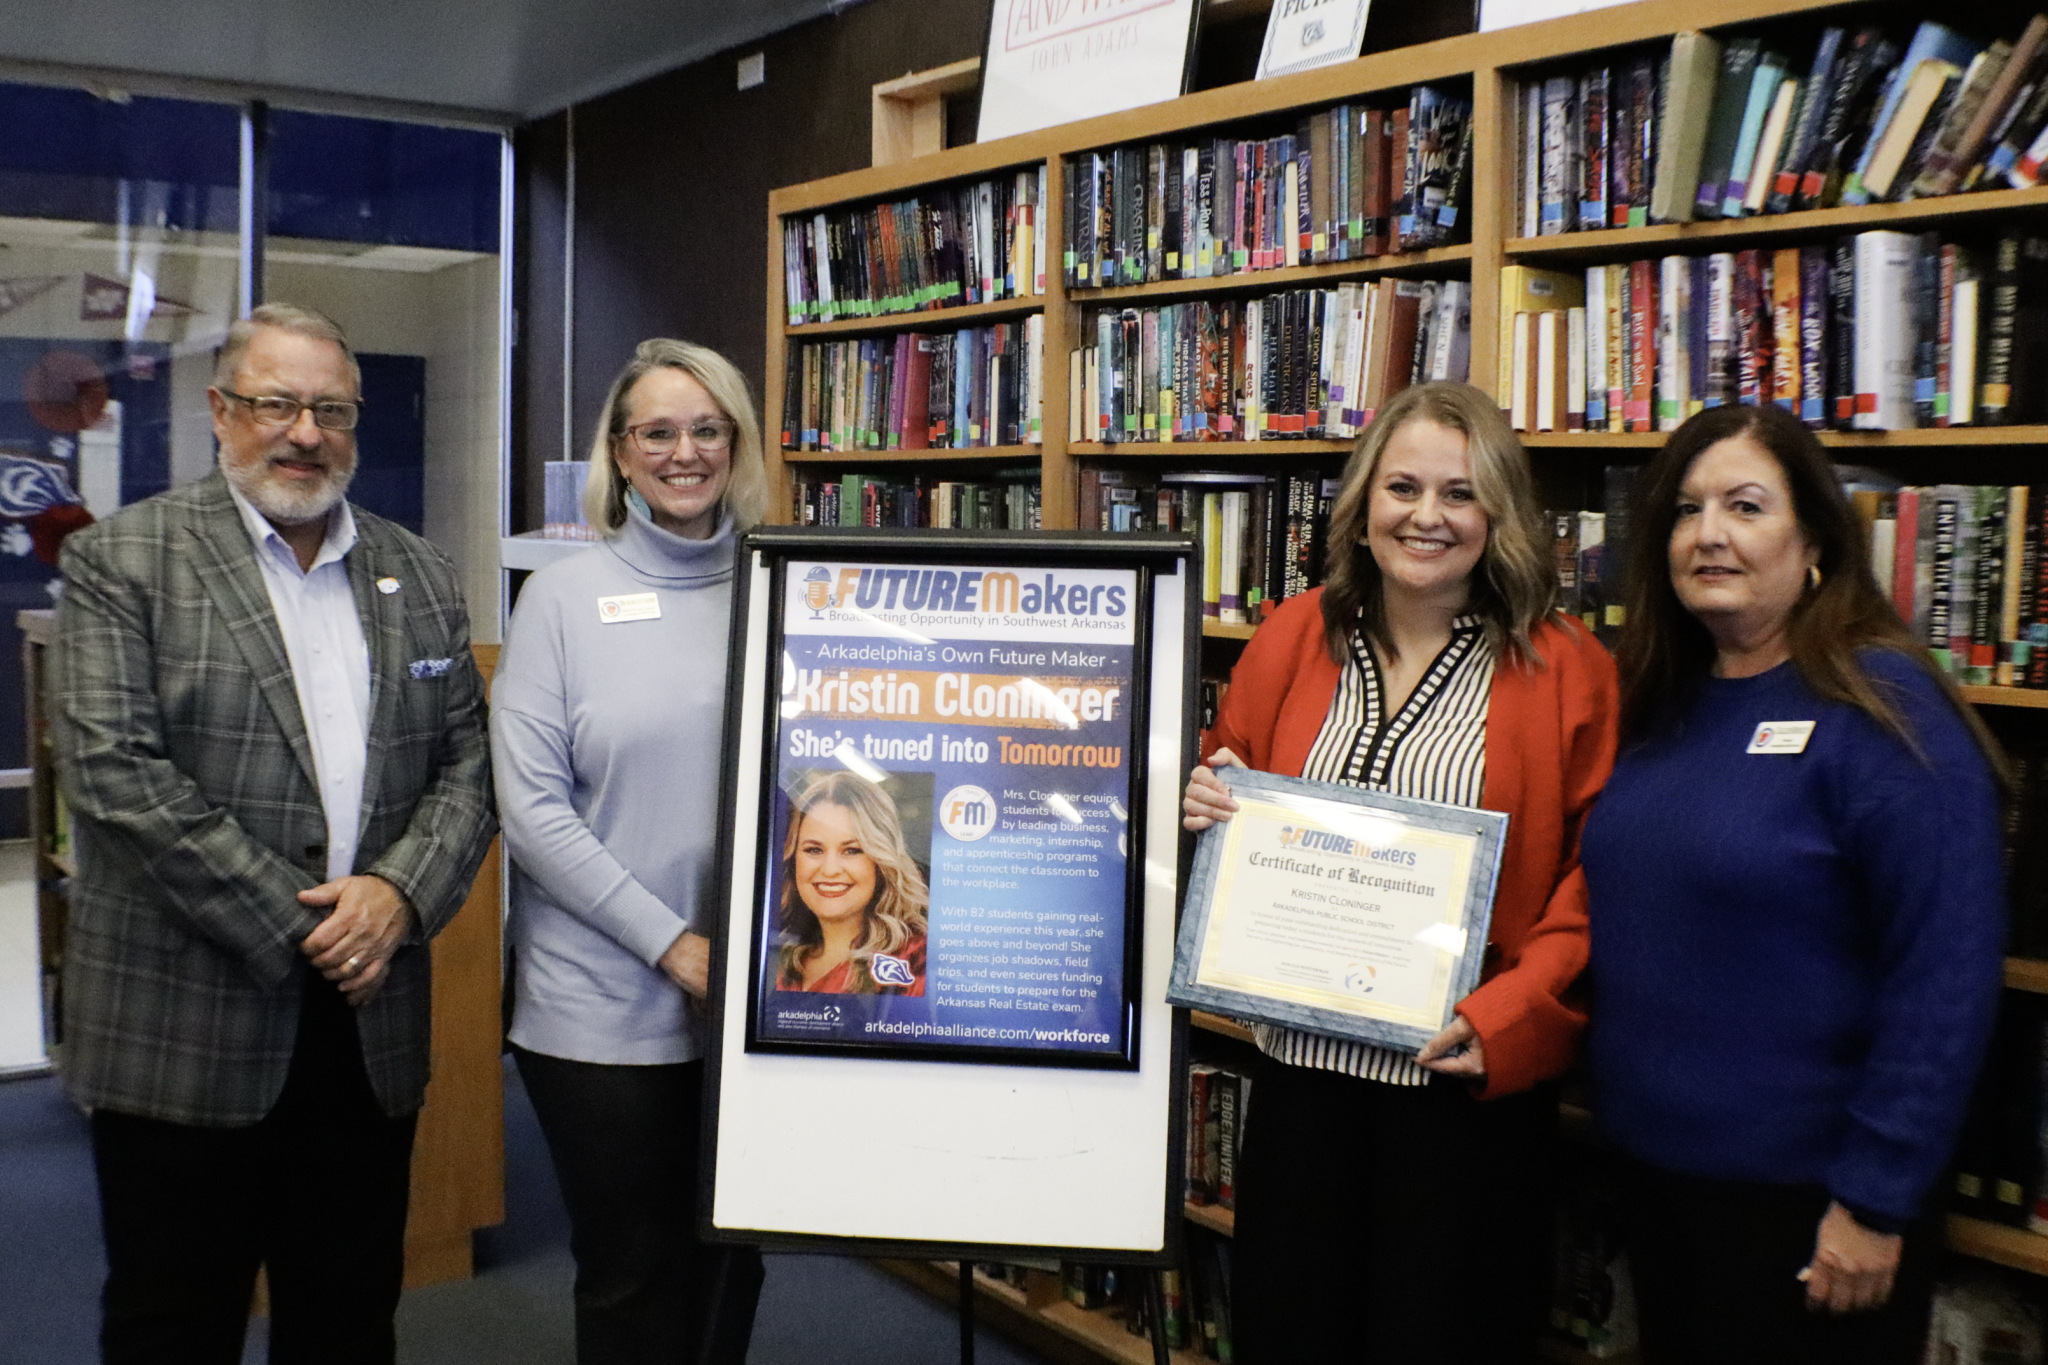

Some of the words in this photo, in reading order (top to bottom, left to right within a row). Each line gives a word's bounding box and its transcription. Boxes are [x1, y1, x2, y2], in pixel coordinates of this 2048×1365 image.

[1031, 42, 1072, 73] JOHN
[1083, 24, 1138, 61] ADAMS
[1269, 336, 1278, 363] HEX
[1312, 326, 1321, 366] SCHOOL
[1221, 382, 1228, 390] IS
[1246, 363, 1254, 398] RASH
[1268, 370, 1277, 404] HALL
[1221, 392, 1228, 403] ON
[1309, 371, 1319, 411] SPIRITS
[1306, 495, 1314, 520] FINAL
[1285, 533, 1293, 579] HAUNTED
[1290, 565, 1297, 576] TO
[910, 612, 984, 628] Opportunity
[988, 614, 999, 626] in
[1003, 615, 1067, 628] Southwest
[1071, 617, 1126, 630] Arkansas
[817, 643, 936, 664] Arkadelphia's
[942, 647, 984, 664] Own
[989, 648, 1046, 665] Future
[1052, 651, 1106, 668] Maker
[798, 668, 920, 715] Kristin
[863, 733, 934, 762] tuned
[941, 734, 989, 764] into
[997, 735, 1122, 769] Tomorrow
[1003, 789, 1026, 800] Mrs.
[1083, 793, 1119, 805] equips
[1003, 805, 1049, 816] students
[1002, 819, 1016, 832] by
[1018, 820, 1057, 833] leading
[1061, 821, 1109, 834] business,
[989, 835, 1045, 848] marketing,
[1049, 837, 1104, 850] internship,
[943, 847, 963, 857] and
[966, 849, 1044, 862] apprenticeship
[1046, 852, 1098, 864] programs
[942, 862, 964, 872] that
[967, 864, 1009, 875] connect
[1011, 864, 1028, 875] the
[1031, 865, 1085, 876] classroom
[1088, 867, 1099, 877] to
[1249, 851, 1323, 878] Certificate
[1327, 867, 1344, 881] of
[1348, 867, 1435, 898] Recognition
[942, 877, 960, 887] the
[962, 879, 1020, 891] workplace.
[1291, 887, 1327, 903] KRISTIN
[1328, 895, 1381, 913] CLONINGER
[941, 906, 968, 917] With
[970, 908, 985, 918] 82
[987, 909, 1034, 920] students
[1036, 910, 1076, 923] gaining
[1078, 912, 1104, 923] real-
[1272, 901, 1315, 916] ARKADELPHIA
[1316, 910, 1339, 921] PUBLIC
[1340, 915, 1365, 926] SCHOOL
[1366, 919, 1395, 931] DISTRICT
[940, 922, 971, 932] world
[974, 923, 1031, 936] experience
[1034, 925, 1053, 936] this
[1056, 926, 1082, 939] year,
[1085, 927, 1104, 938] she
[939, 937, 965, 949] goes
[967, 938, 999, 949] above
[1002, 939, 1023, 949] and
[1025, 940, 1068, 952] beyond!
[1071, 941, 1091, 952] She
[938, 952, 989, 964] organizes
[991, 953, 1009, 965] job
[1011, 954, 1062, 967] shadows,
[1065, 956, 1088, 967] field
[938, 967, 964, 979] trips,
[967, 967, 987, 978] and
[990, 970, 1015, 979] even
[1018, 971, 1059, 981] secures
[1061, 971, 1103, 985] funding
[937, 981, 952, 991] for
[954, 982, 1000, 993] students
[1003, 984, 1015, 994] to
[1017, 985, 1059, 998] prepare
[1061, 986, 1077, 997] for
[1079, 987, 1097, 998] the
[936, 996, 986, 1008] Arkansas
[988, 998, 1012, 1009] Real
[1015, 1000, 1049, 1011] Estate
[1052, 1002, 1084, 1013] exam.
[777, 1007, 823, 1022] arkadelphia
[865, 1021, 1110, 1044] arkadelphiaalliance.com/workforce
[1221, 1093, 1233, 1129] EDGE
[1220, 1133, 1233, 1186] UNIVER
